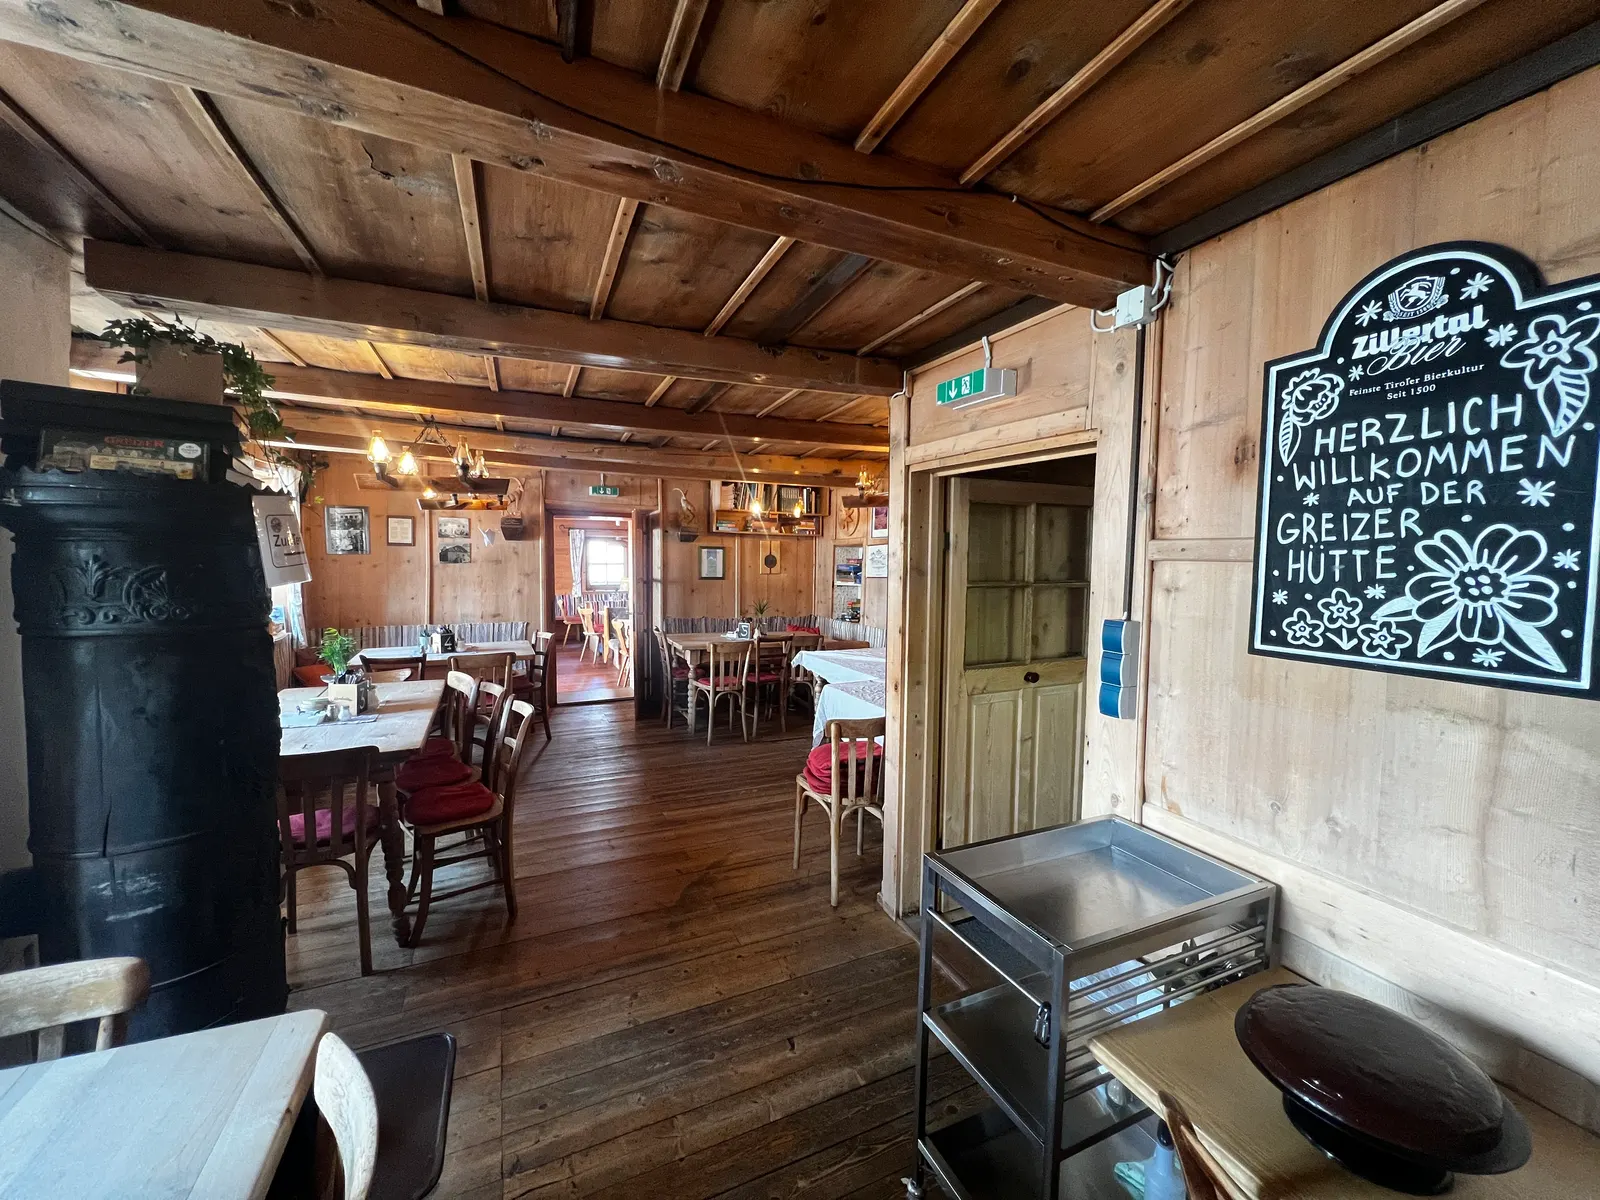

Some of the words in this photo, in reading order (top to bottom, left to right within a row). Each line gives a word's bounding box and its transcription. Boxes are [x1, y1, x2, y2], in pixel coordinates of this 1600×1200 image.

[1351, 304, 1490, 359] Zillertal
[1366, 336, 1467, 376] Bier
[1349, 386, 1382, 397] Feinste
[1384, 376, 1421, 391] Tiroler
[1424, 364, 1485, 382] Bierkultur
[1386, 392, 1407, 400] Seit
[1410, 384, 1437, 396] 1500
[1314, 394, 1523, 456] HERZLICH
[1292, 434, 1577, 492] WILLKOMMEN
[1346, 483, 1403, 507] AUF
[1420, 479, 1487, 505] DER
[1276, 508, 1424, 545] GREIZER
[1287, 545, 1398, 585] HÜTTE
[444, 637, 453, 650] 4
[740, 625, 749, 637] 5
[359, 688, 366, 710] 3
